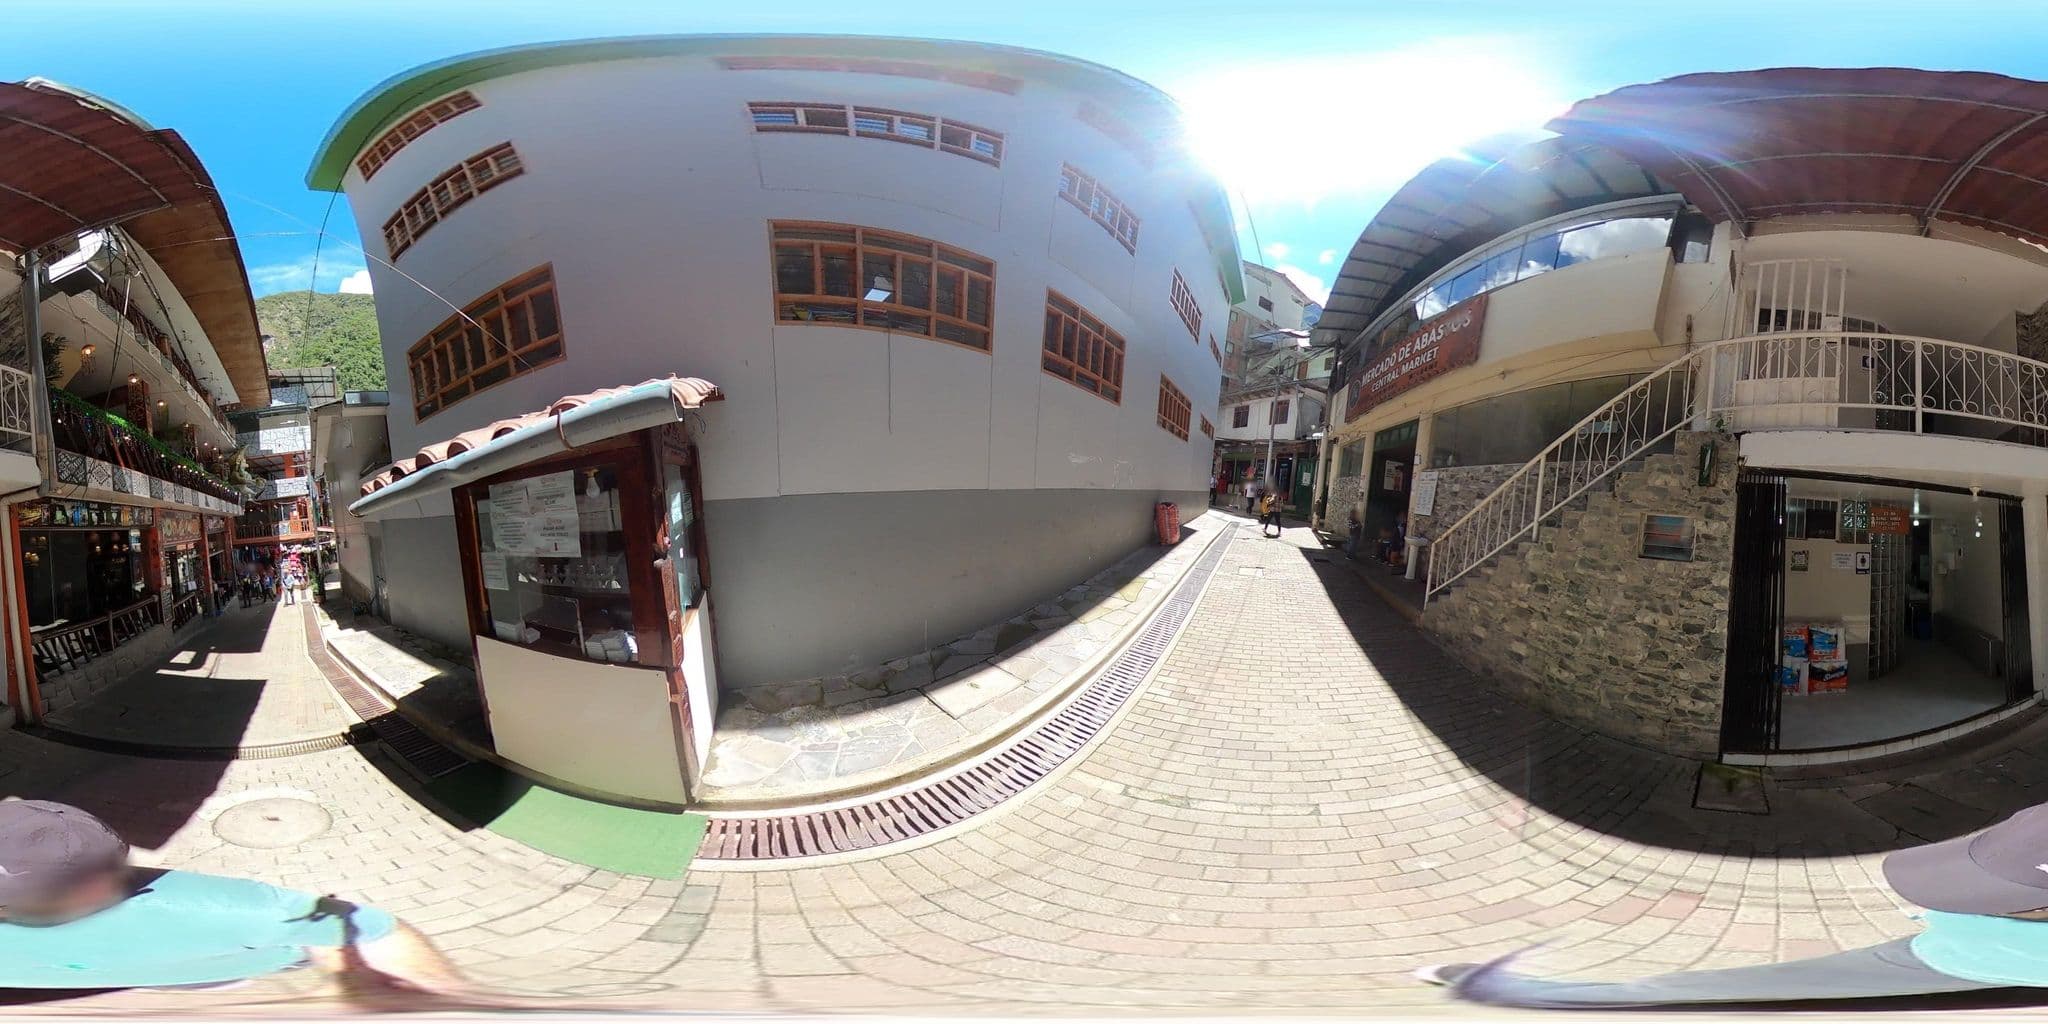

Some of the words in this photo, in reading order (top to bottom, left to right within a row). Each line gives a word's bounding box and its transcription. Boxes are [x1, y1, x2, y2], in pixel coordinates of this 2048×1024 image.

[1362, 352, 1396, 387] MERCADO
[1398, 342, 1412, 363] DE
[1372, 368, 1399, 392] CENTRAL
[1401, 346, 1439, 375] MARKET
